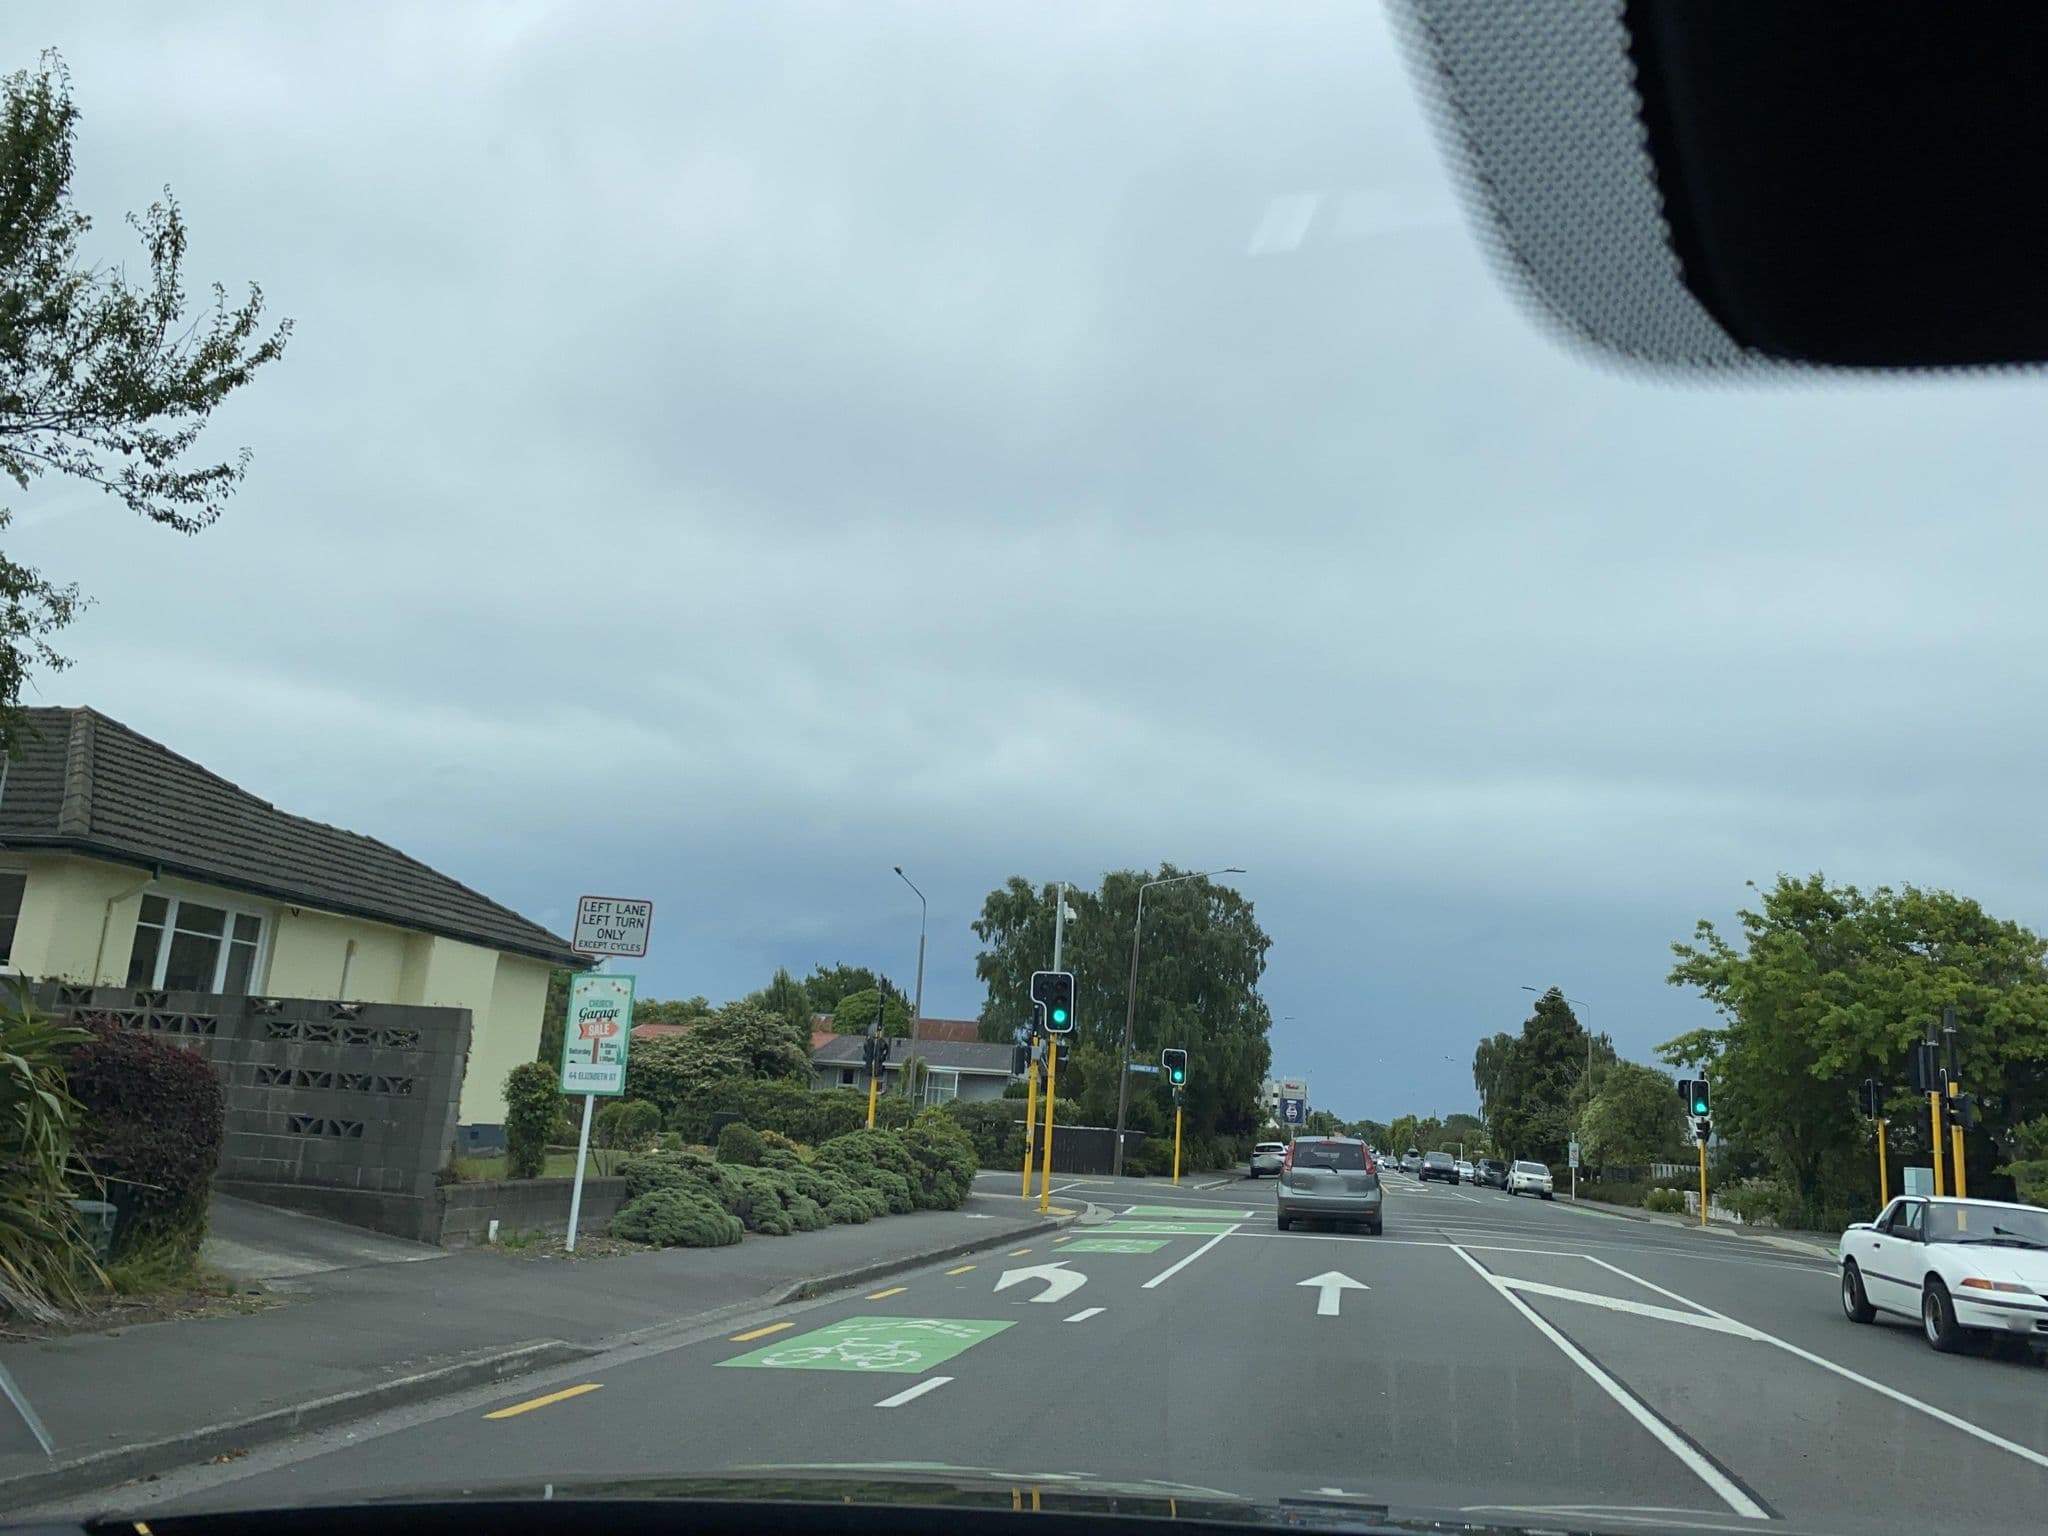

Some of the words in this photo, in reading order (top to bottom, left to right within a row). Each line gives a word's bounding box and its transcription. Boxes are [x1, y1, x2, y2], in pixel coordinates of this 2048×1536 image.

[583, 901, 612, 913] LEFT
[616, 903, 647, 917] LANE
[582, 914, 610, 926] LEFT
[615, 916, 645, 928] TURN
[596, 928, 626, 941] ONLY
[578, 940, 608, 950] EXCEPT
[610, 942, 641, 952] CYCLES
[579, 1007, 621, 1023] Garage
[588, 1023, 610, 1035] SALE
